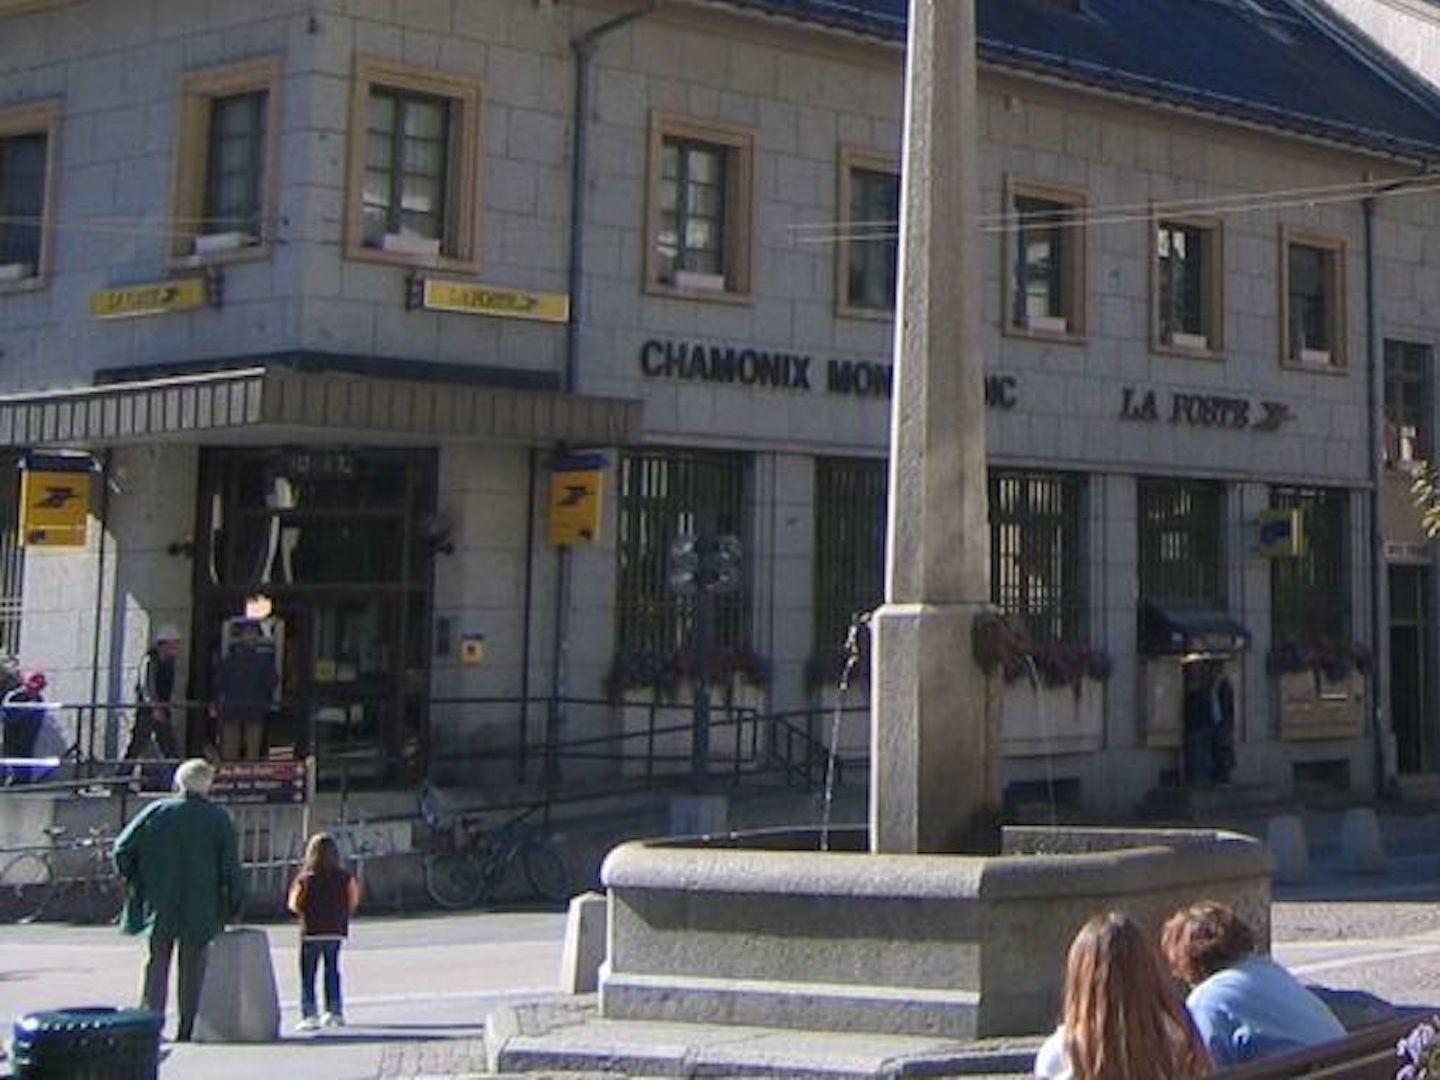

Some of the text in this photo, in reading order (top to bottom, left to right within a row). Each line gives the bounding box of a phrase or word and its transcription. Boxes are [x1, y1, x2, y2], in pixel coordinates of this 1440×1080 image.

[641, 340, 893, 397] CHAMONIX MON
[1119, 387, 1249, 427] LA POSTE
